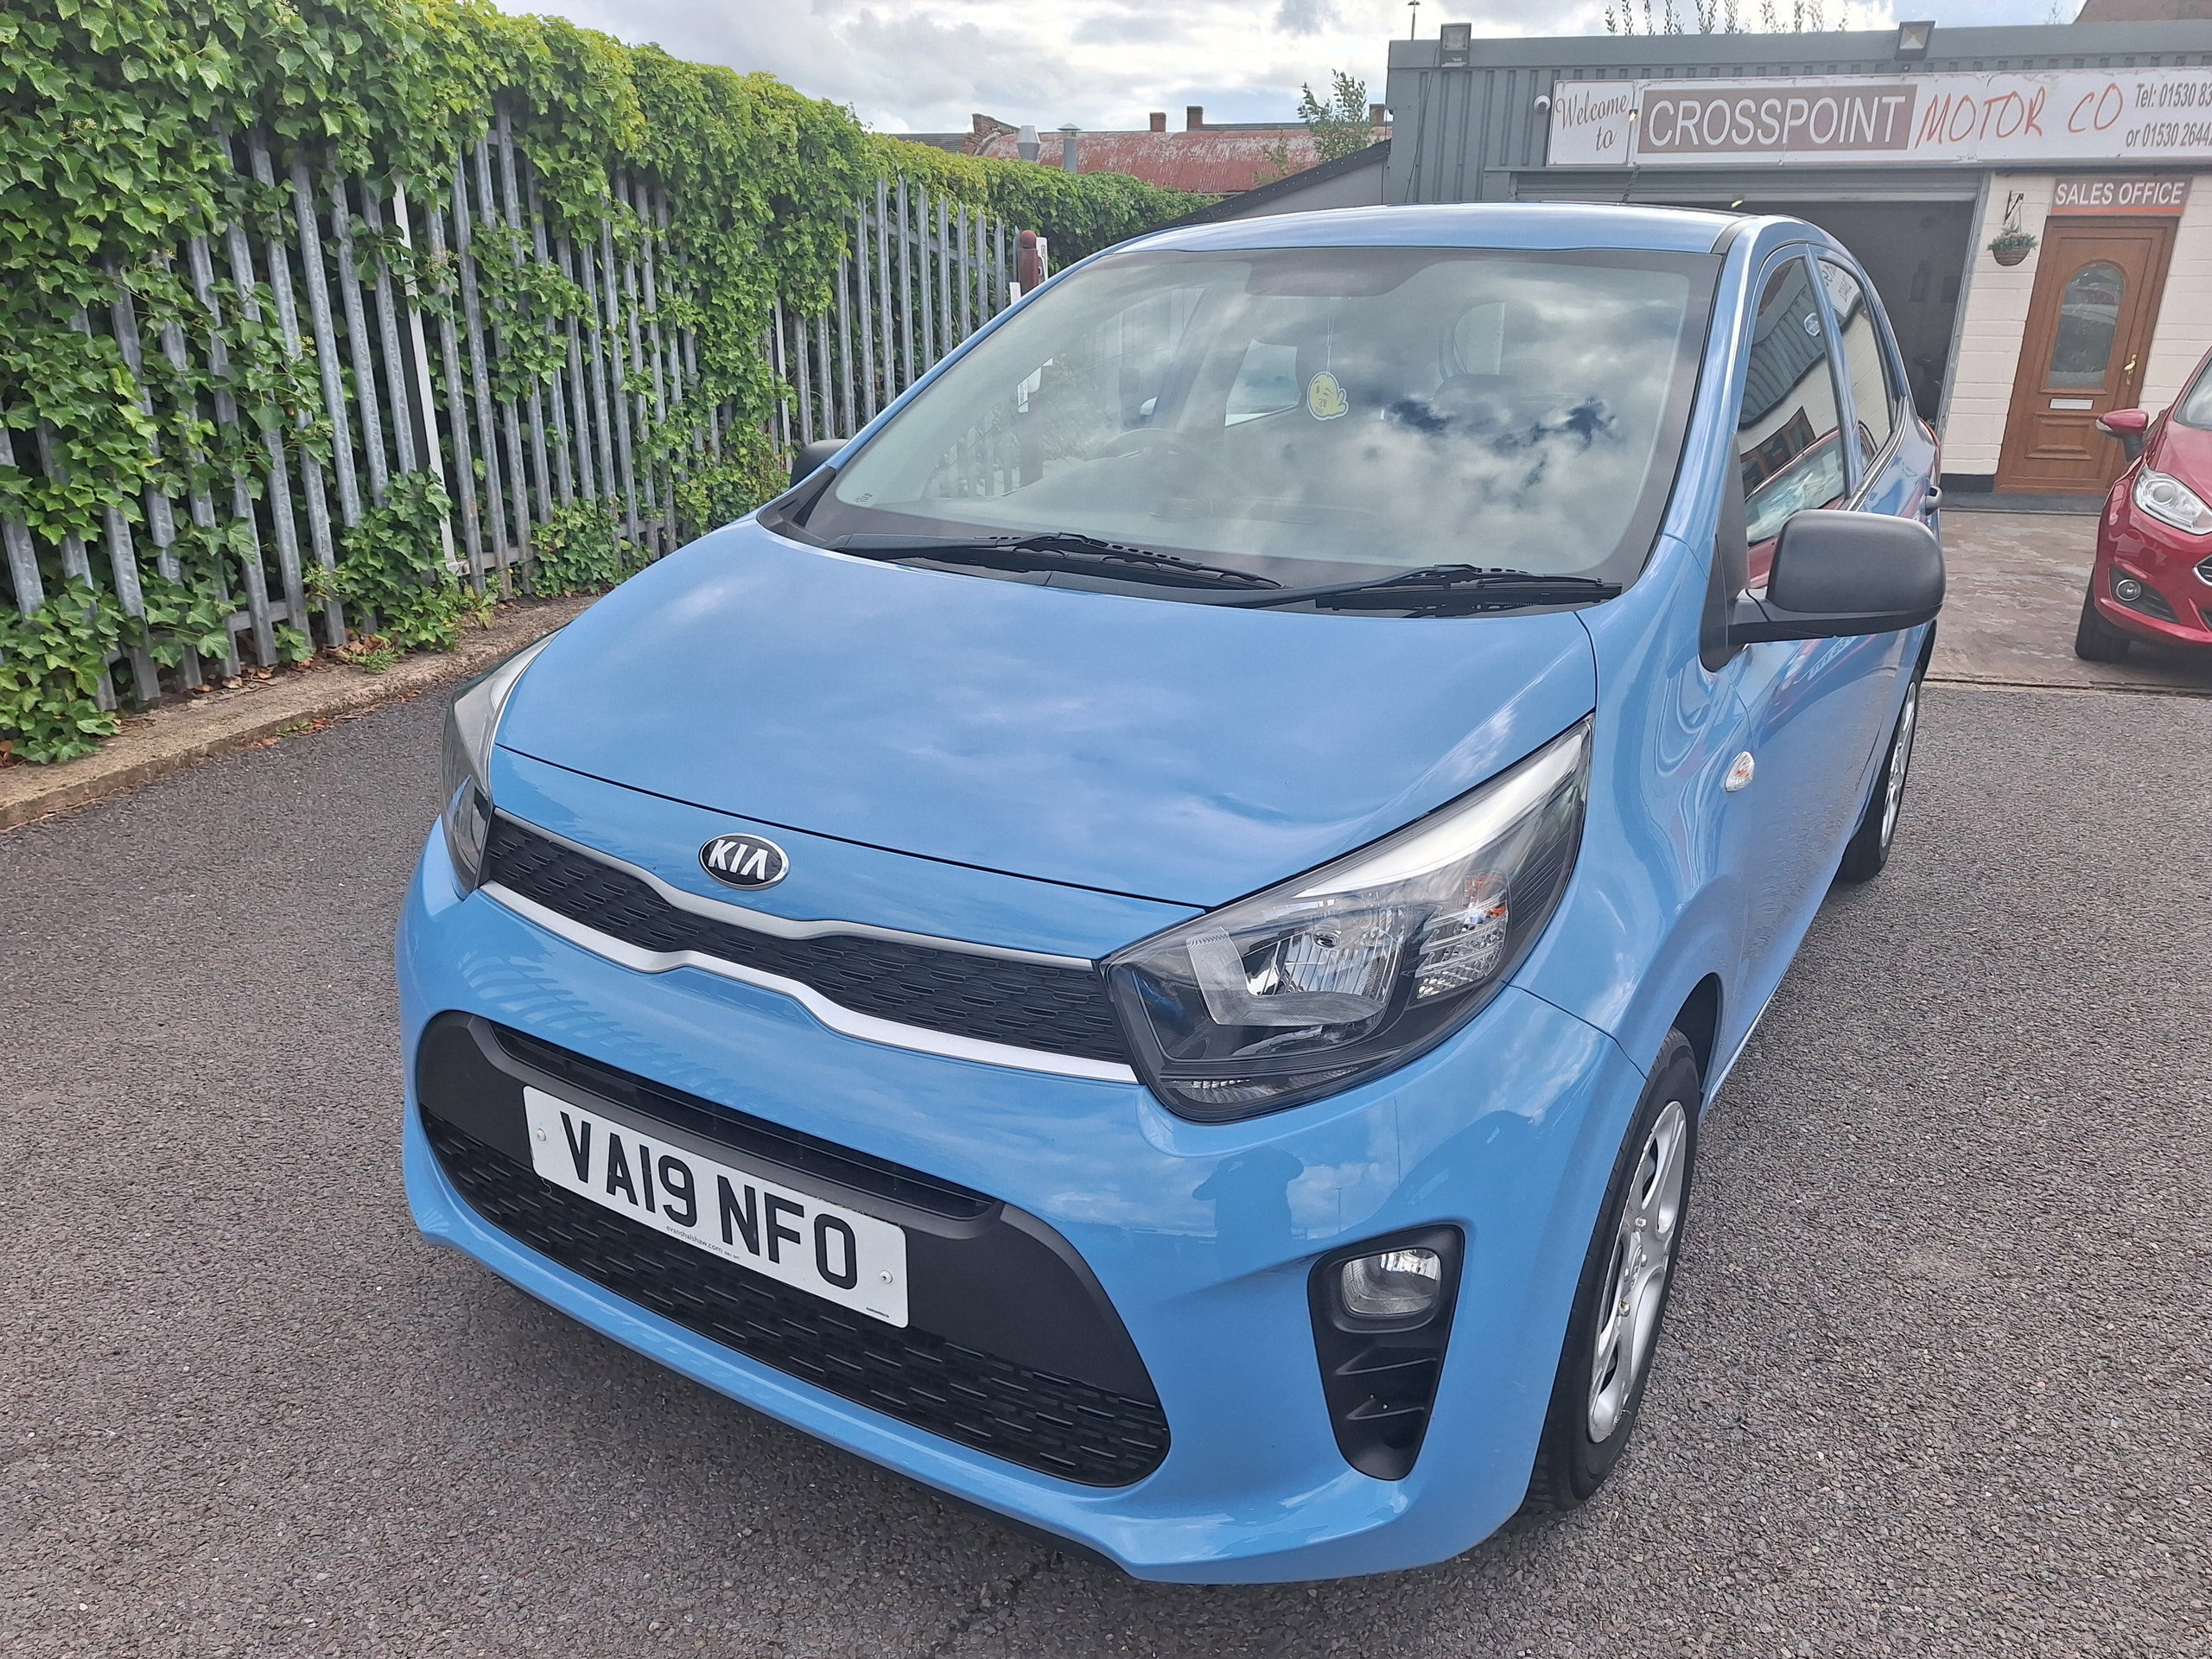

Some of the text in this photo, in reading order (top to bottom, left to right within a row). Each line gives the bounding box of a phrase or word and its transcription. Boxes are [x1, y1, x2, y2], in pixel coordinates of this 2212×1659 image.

[2135, 83, 2157, 108] Tel:
[2159, 82, 2196, 107] 01530
[1555, 90, 1629, 130] Welcome
[1649, 82, 2123, 149] CROSSPOINT MOTOR CO
[1596, 125, 1617, 151] to
[2126, 128, 2140, 148] or
[2142, 122, 2179, 147] 01530
[2056, 181, 2185, 206] SALES OFFICE
[709, 839, 768, 880] KIA
[559, 1110, 858, 1291] VA19 NFO
[666, 1225, 723, 1254] evanshalshaw.com
